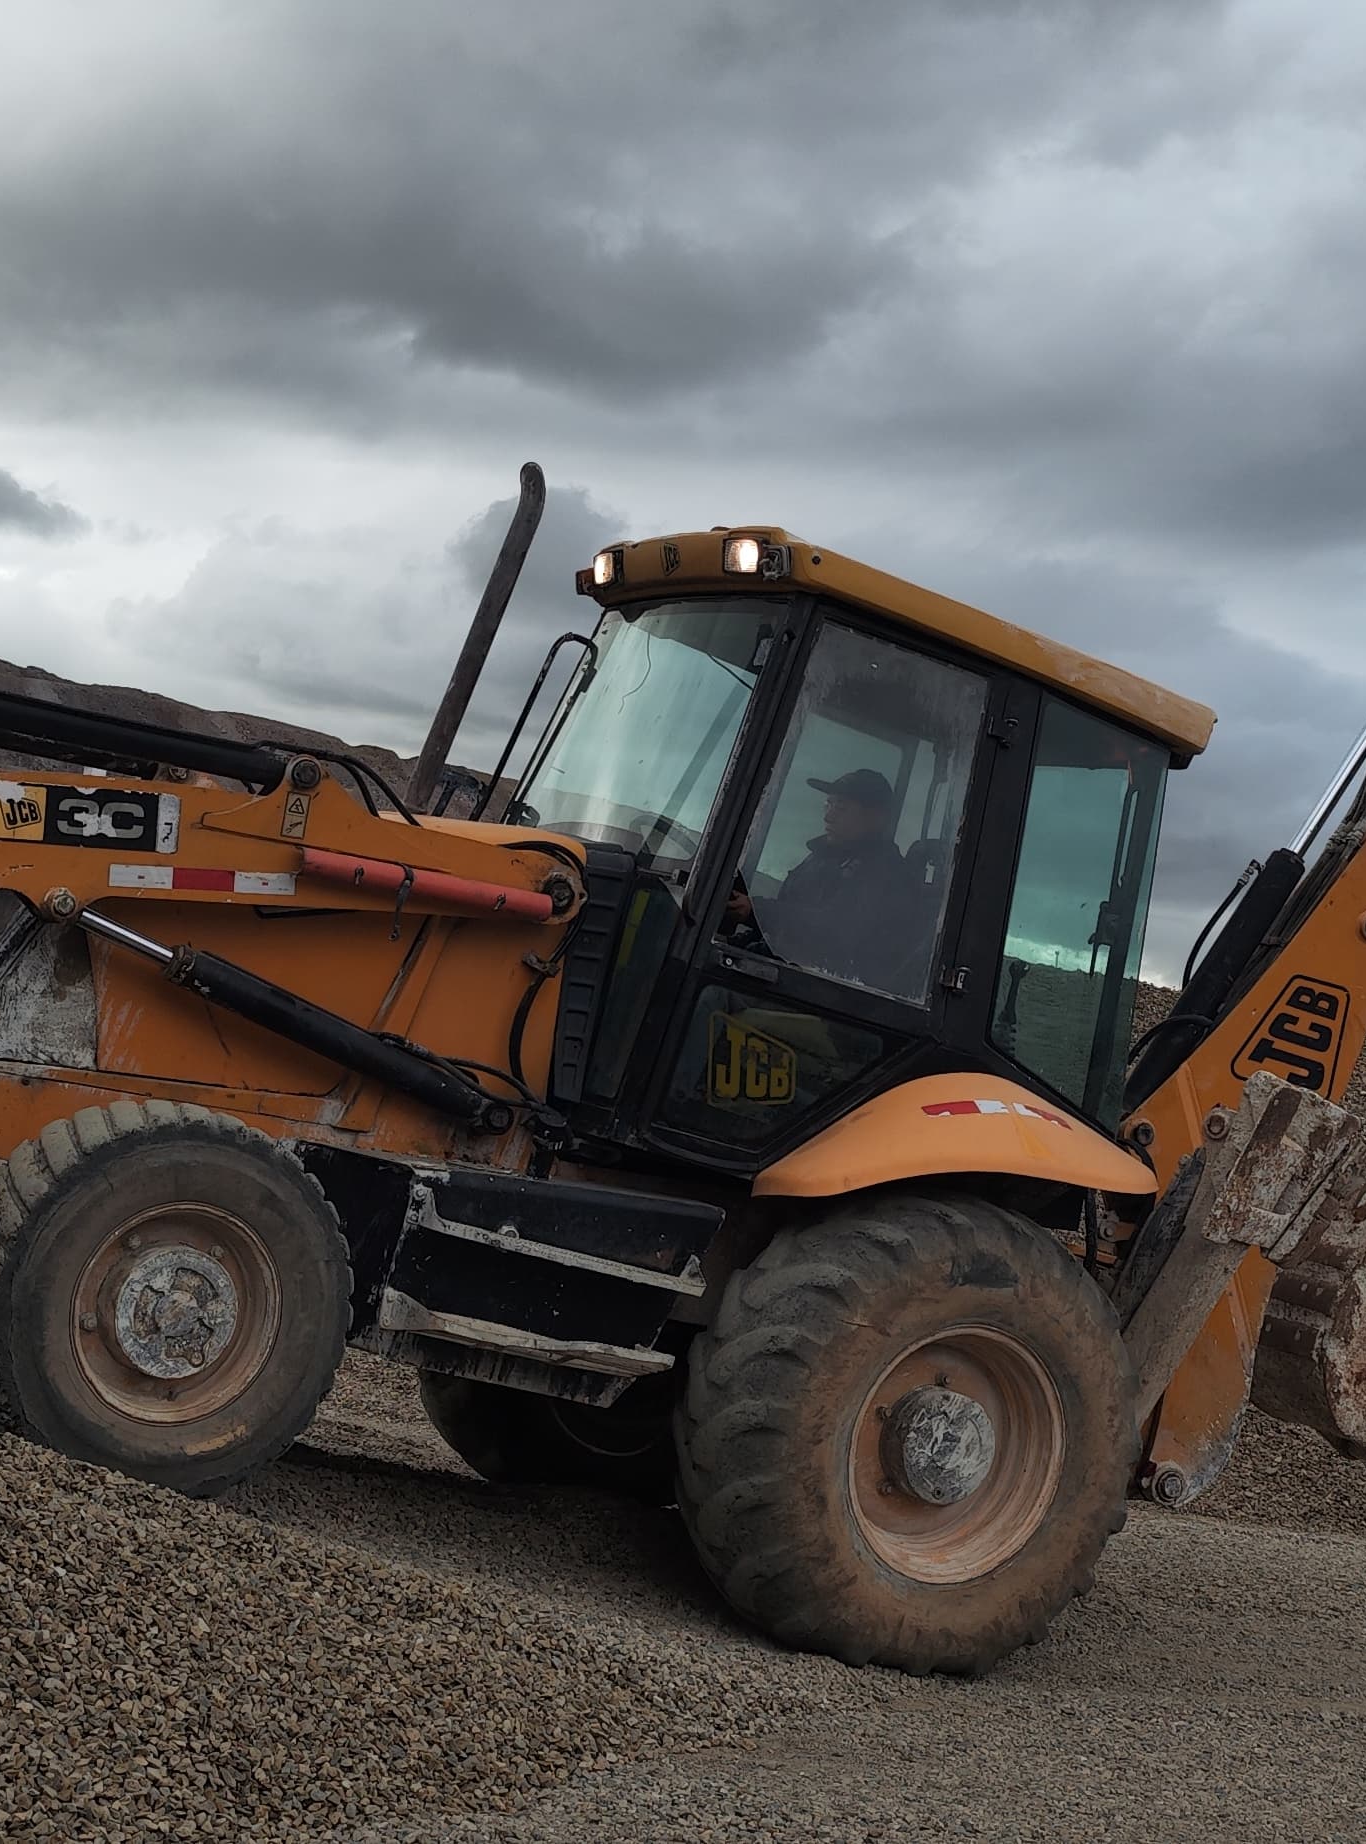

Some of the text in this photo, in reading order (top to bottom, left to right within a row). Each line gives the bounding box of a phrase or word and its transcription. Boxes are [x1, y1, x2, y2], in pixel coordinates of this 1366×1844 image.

[6, 799, 40, 826] JCB
[56, 799, 145, 839] 3C
[715, 1024, 789, 1098] JCB
[1247, 986, 1339, 1090] JCB
